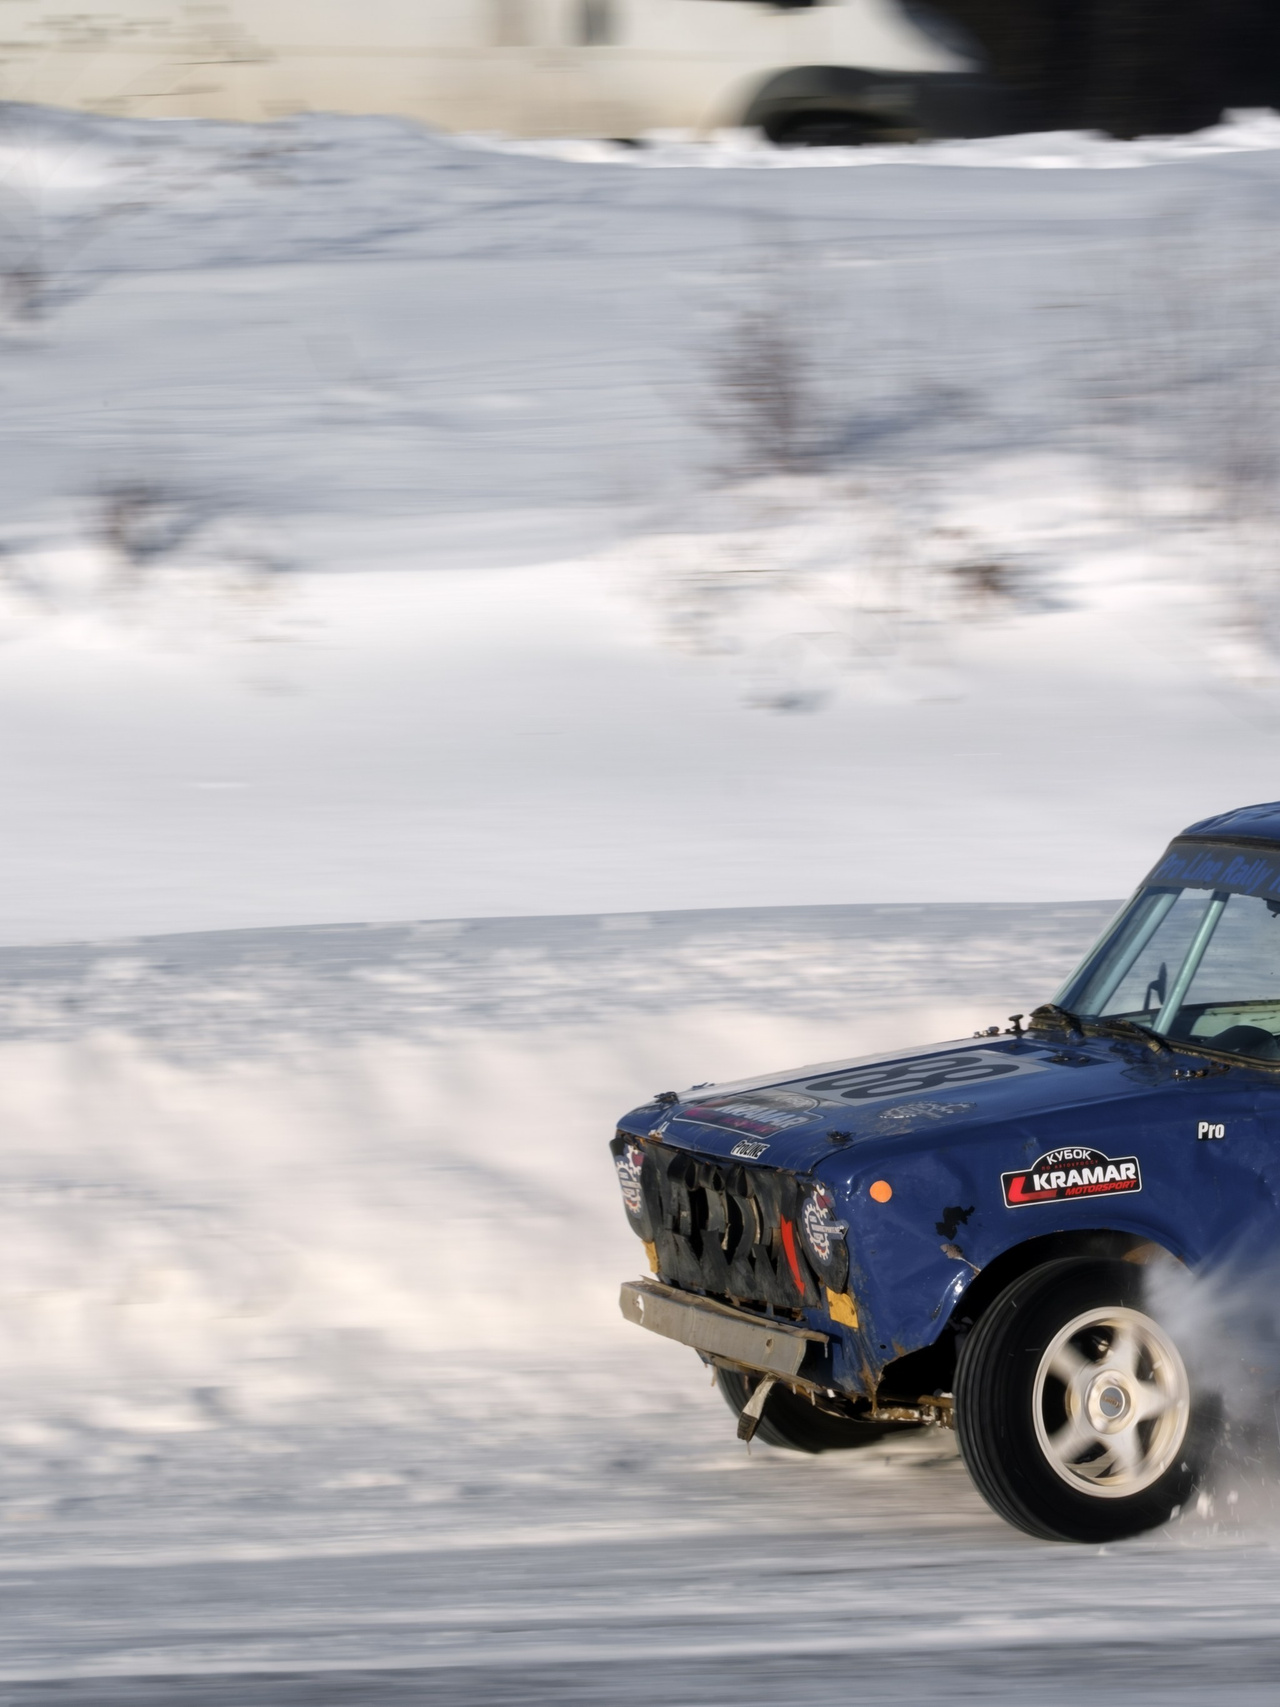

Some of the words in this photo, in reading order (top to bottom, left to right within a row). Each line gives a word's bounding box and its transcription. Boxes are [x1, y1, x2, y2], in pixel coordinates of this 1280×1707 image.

[1152, 853, 1185, 880] Pro
[1182, 853, 1223, 882] Line
[1218, 856, 1273, 894] Rally
[805, 1056, 1020, 1099] 88
[1198, 1121, 1225, 1139] Pro
[1046, 1149, 1092, 1166] КУБОК
[1033, 1162, 1137, 1191] KRAMAR
[1065, 1180, 1137, 1196] MOTORSPORT
